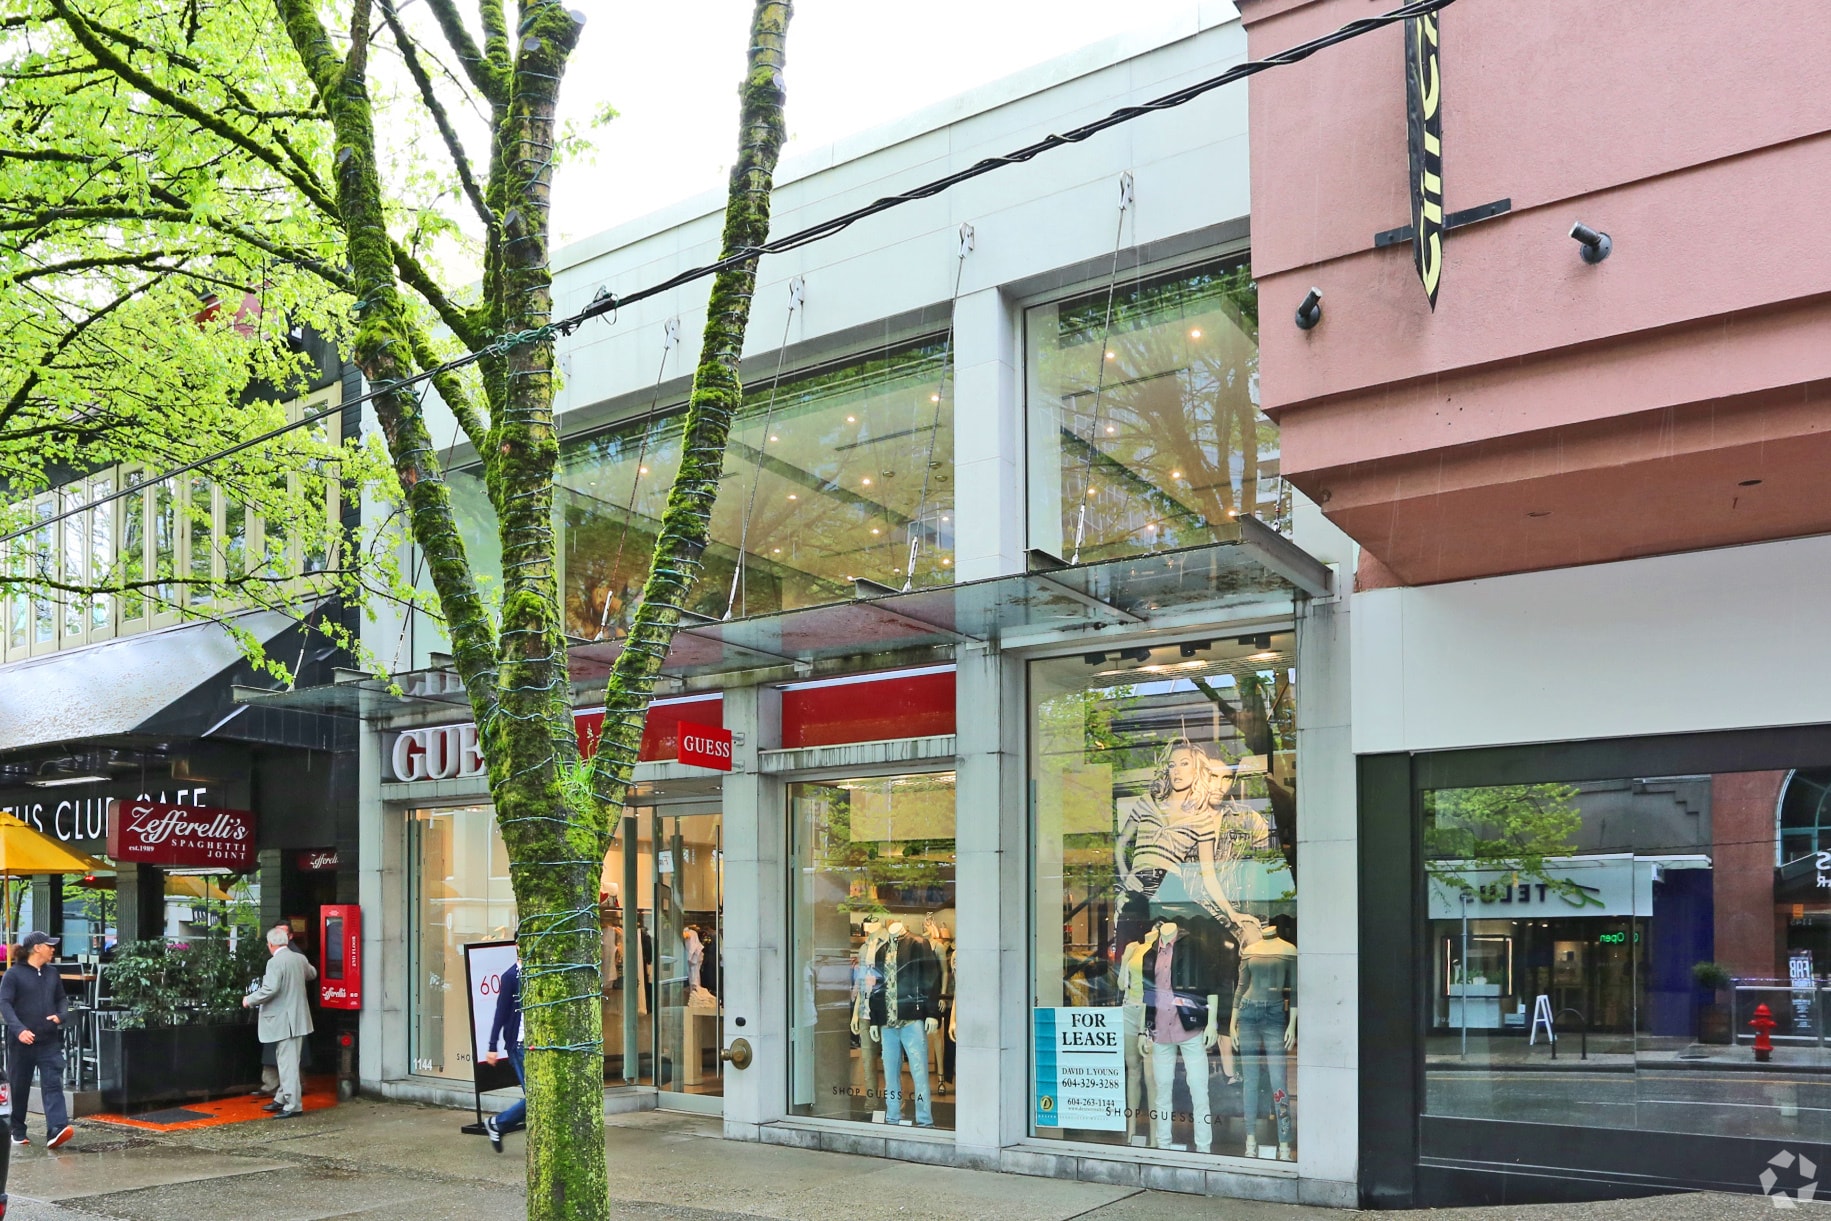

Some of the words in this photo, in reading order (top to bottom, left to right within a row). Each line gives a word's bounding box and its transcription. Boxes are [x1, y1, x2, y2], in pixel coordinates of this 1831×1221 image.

[684, 735, 730, 758] GUESS
[127, 806, 248, 844] Zefferelli's
[171, 838, 247, 851] SPAGHETTI
[207, 850, 246, 860] JOINT
[1071, 1013, 1106, 1028] FOR
[1062, 1031, 1117, 1047] LEASE
[413, 1057, 433, 1071] 1144
[1062, 1067, 1084, 1076] DAVID
[1062, 1078, 1120, 1089] 604-329-3288
[832, 1086, 861, 1097] SHOP
[1067, 1098, 1115, 1107] 604-263-1144
[1106, 1106, 1142, 1119] SHOP
